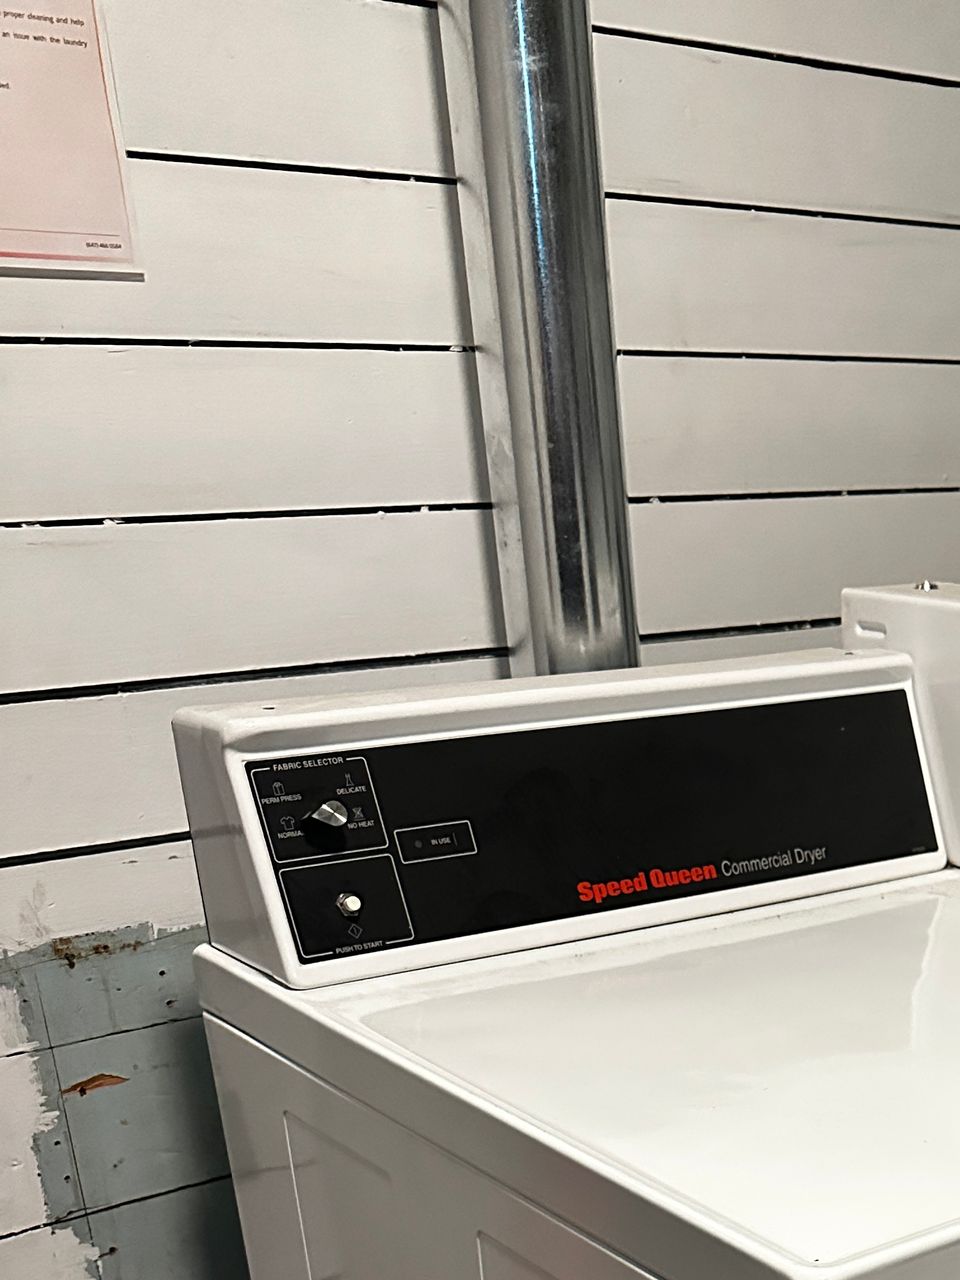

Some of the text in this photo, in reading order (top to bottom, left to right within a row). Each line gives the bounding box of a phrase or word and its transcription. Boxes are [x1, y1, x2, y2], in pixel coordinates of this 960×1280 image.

[3, 11, 85, 27] proper cleaning and help
[33, 35, 47, 43] with
[49, 36, 61, 44] the
[63, 37, 87, 48] laundry
[273, 757, 344, 771] FABRIC SELECTOR
[336, 785, 367, 795] DELICATE
[261, 794, 302, 805] PERM PRESS
[347, 820, 375, 830] NO HEAT
[577, 846, 827, 904] Speed Queen Commercial Dryer
[335, 941, 383, 954] PUSH TO START
